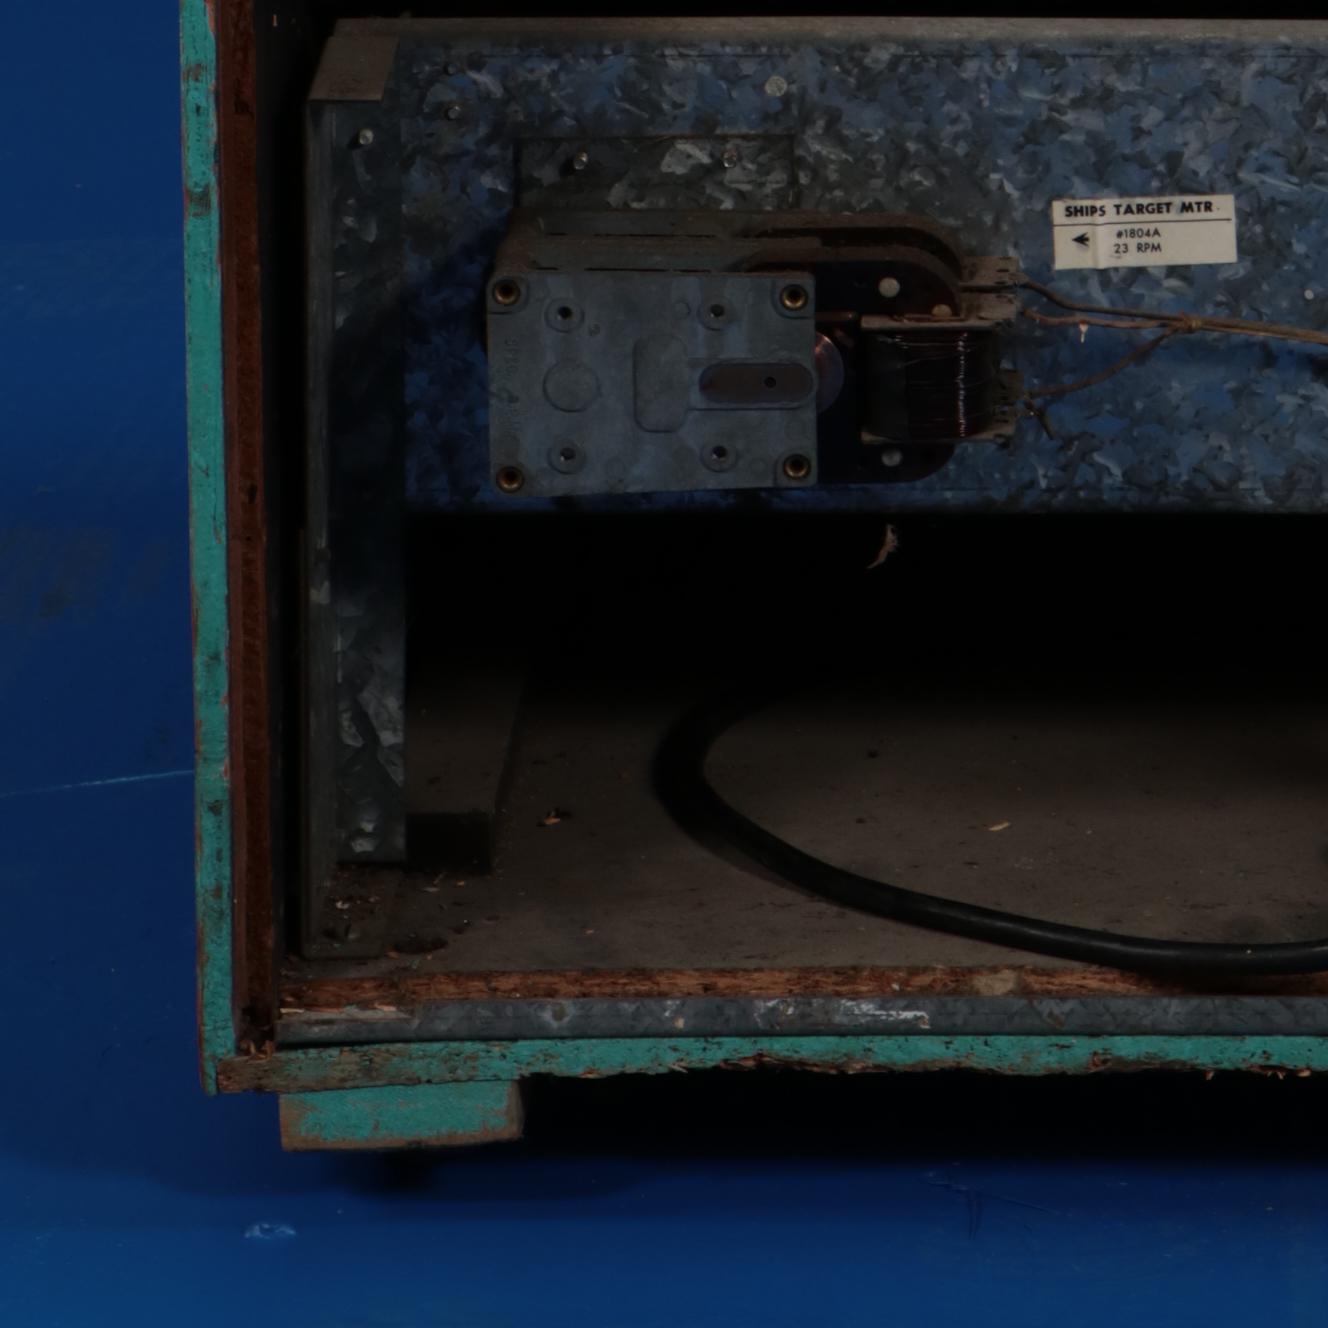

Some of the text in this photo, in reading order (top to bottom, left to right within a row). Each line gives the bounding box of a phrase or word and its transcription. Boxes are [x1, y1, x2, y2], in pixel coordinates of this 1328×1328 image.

[1064, 204, 1106, 218] SHIPS
[1113, 202, 1173, 216] TARGET
[1116, 228, 1162, 239] #1804A
[1114, 242, 1163, 254] 23 RPM
